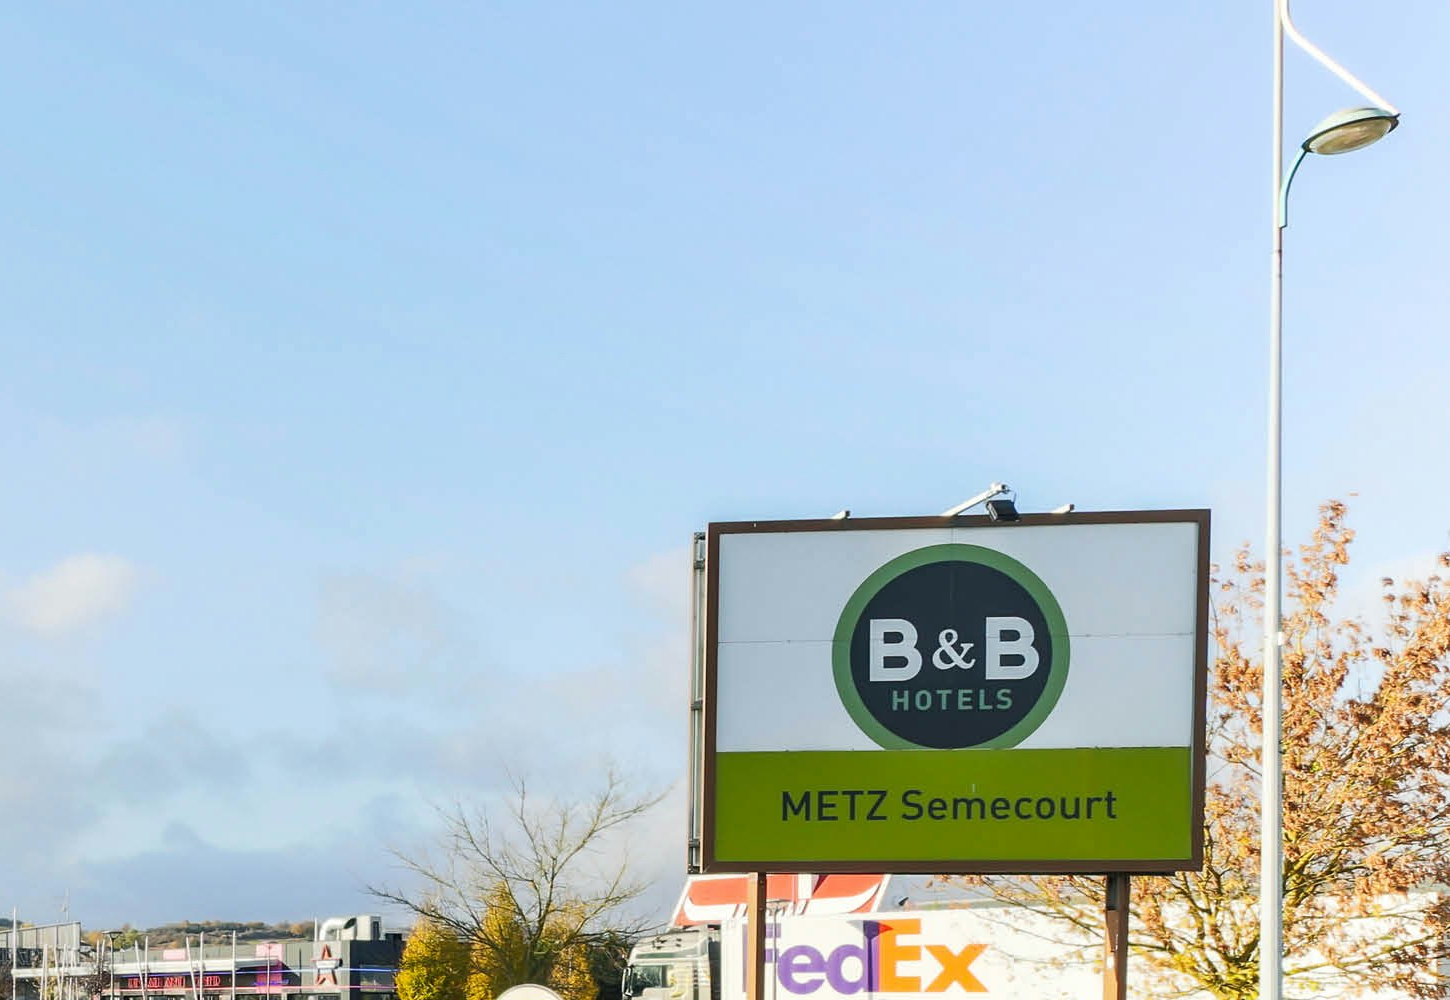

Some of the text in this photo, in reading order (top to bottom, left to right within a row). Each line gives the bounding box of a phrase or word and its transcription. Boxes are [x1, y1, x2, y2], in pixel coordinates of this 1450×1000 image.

[891, 688, 1014, 712] HOTELS
[781, 789, 1118, 821] METZ Semecourt
